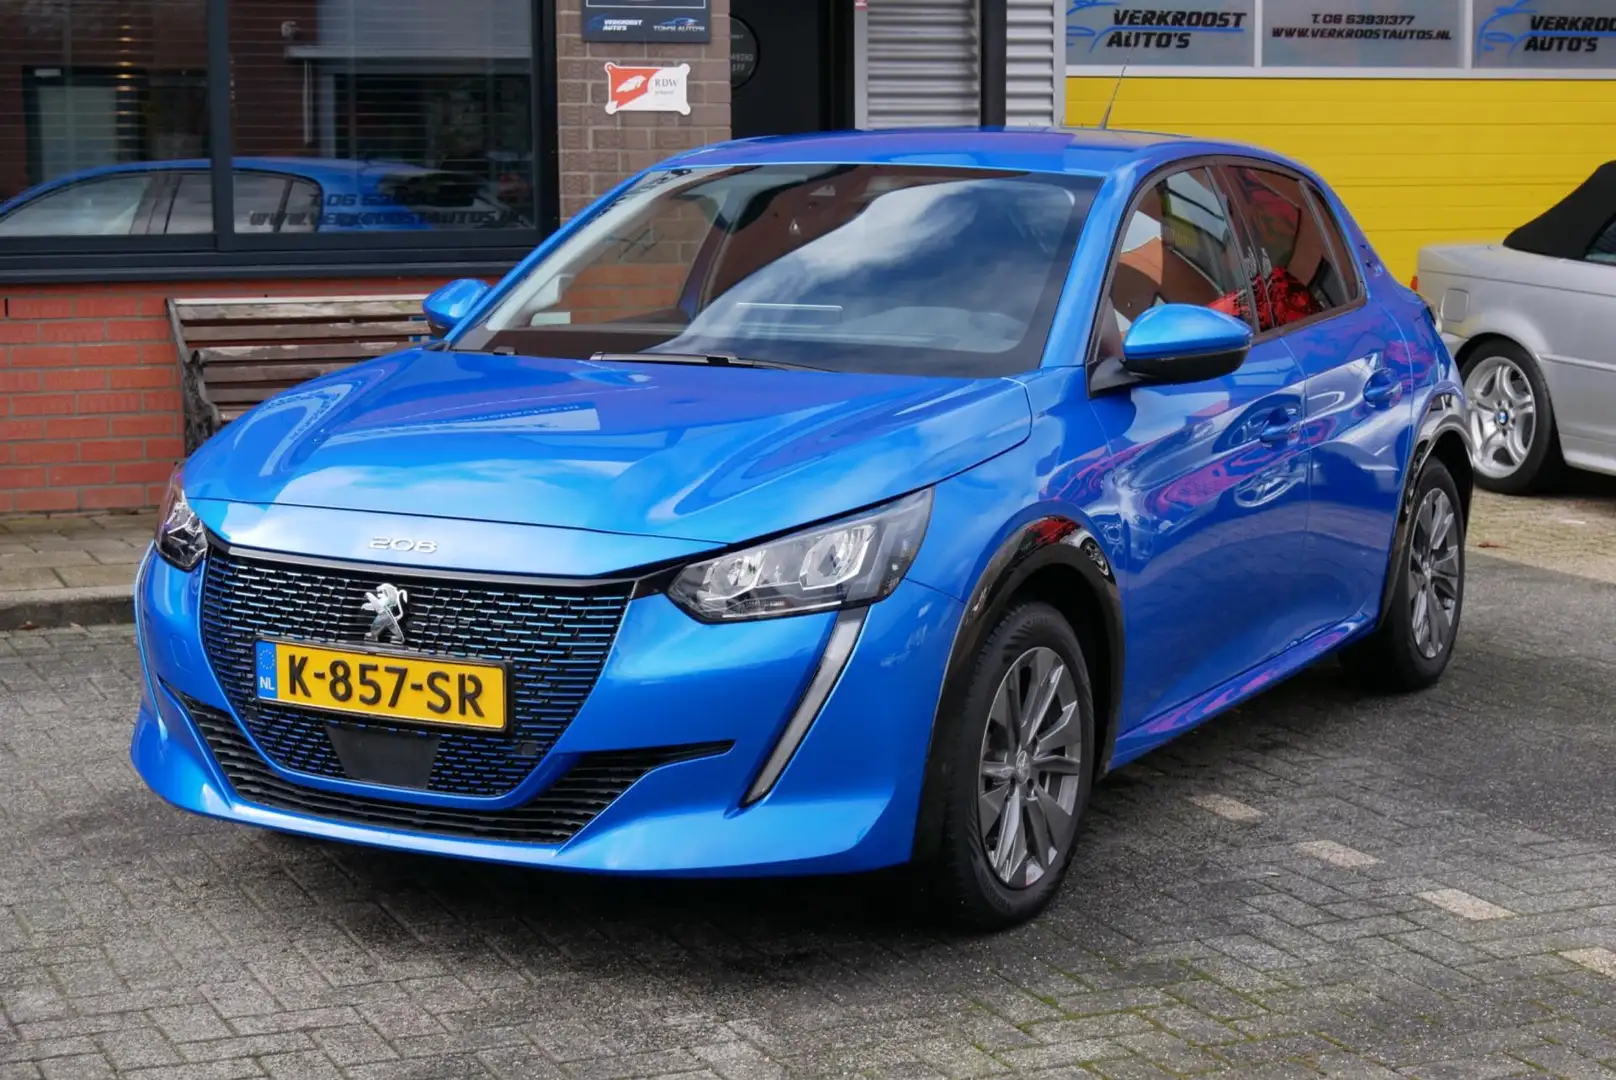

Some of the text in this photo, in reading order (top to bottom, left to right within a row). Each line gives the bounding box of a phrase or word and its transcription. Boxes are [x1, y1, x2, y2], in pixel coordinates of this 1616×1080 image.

[1113, 9, 1247, 27] VERKROOST
[1322, 14, 1343, 24] 06
[1346, 14, 1415, 26] 53931377
[1106, 31, 1192, 48] AUTO'S
[1271, 27, 1453, 40] WWW.VERKROOSTAUTOS.NL
[1524, 36, 1599, 52] AUTO'S
[655, 78, 679, 87] RDW
[368, 536, 438, 553] 208
[259, 676, 275, 691] NL
[288, 654, 485, 717] K-857-SR
